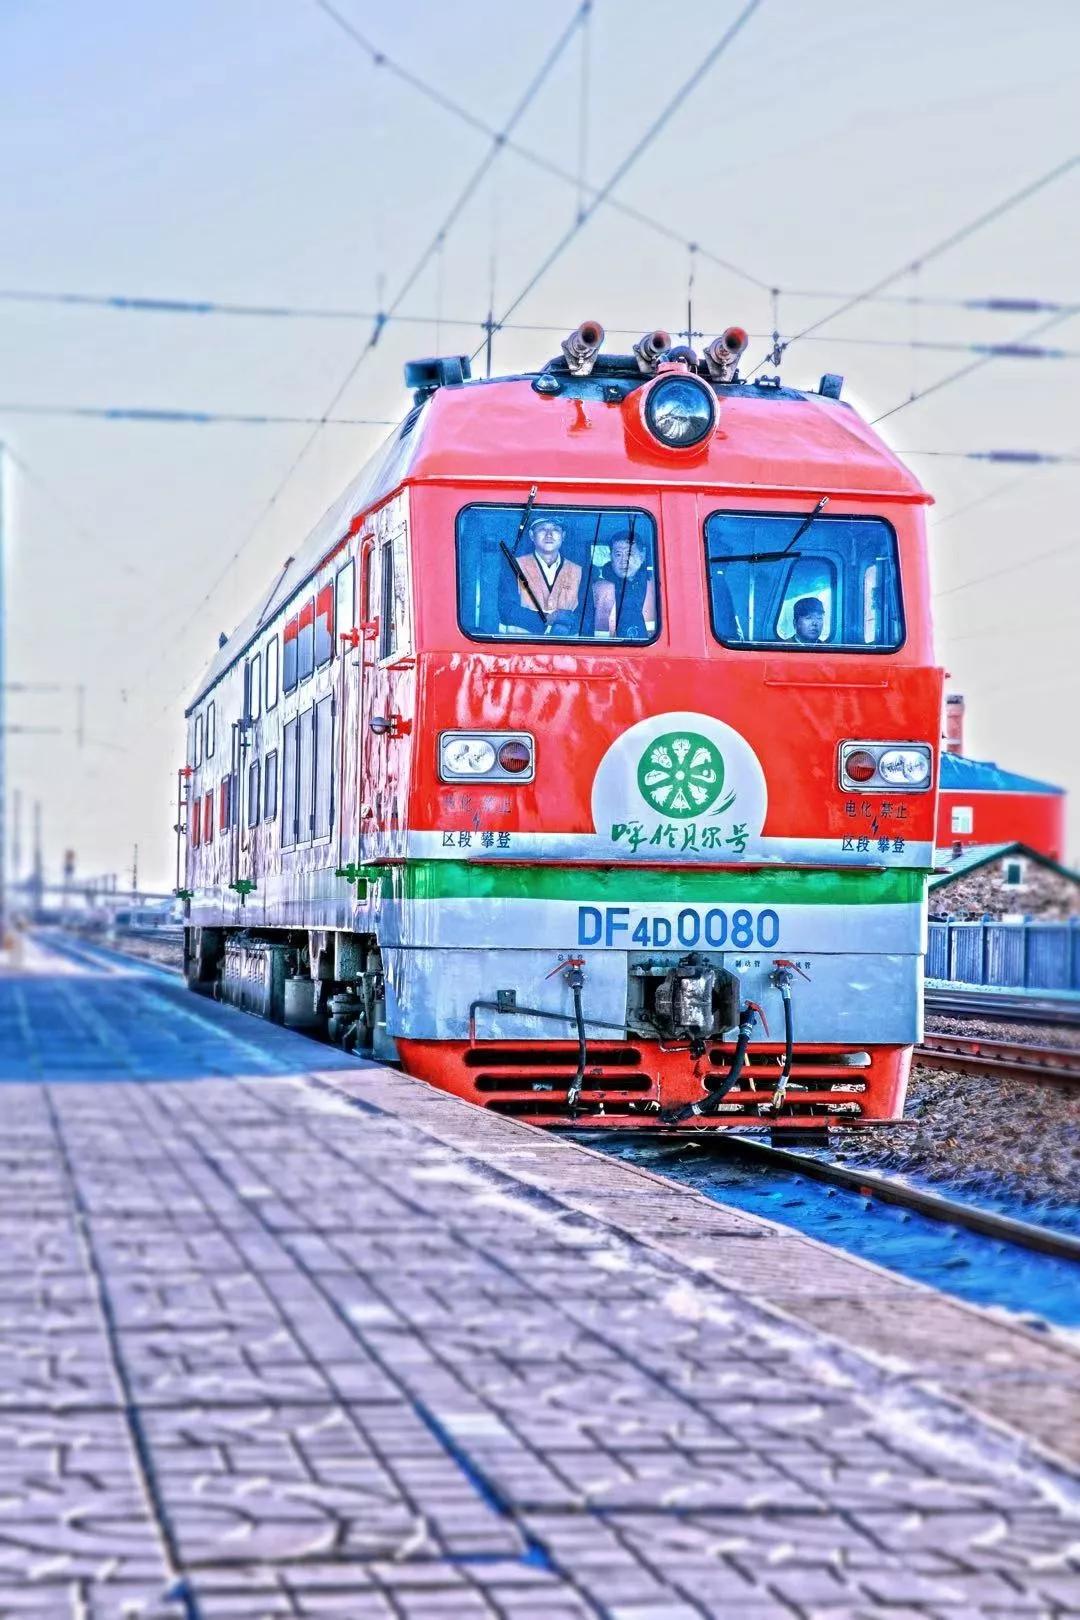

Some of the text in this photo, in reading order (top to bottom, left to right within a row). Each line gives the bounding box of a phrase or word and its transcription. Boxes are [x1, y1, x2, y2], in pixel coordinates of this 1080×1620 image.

[845, 800, 907, 819] 电化 禁止
[442, 831, 511, 848] 区段 攀登
[842, 835, 905, 853] 区段 攀登
[578, 906, 780, 949] DF4D0080
